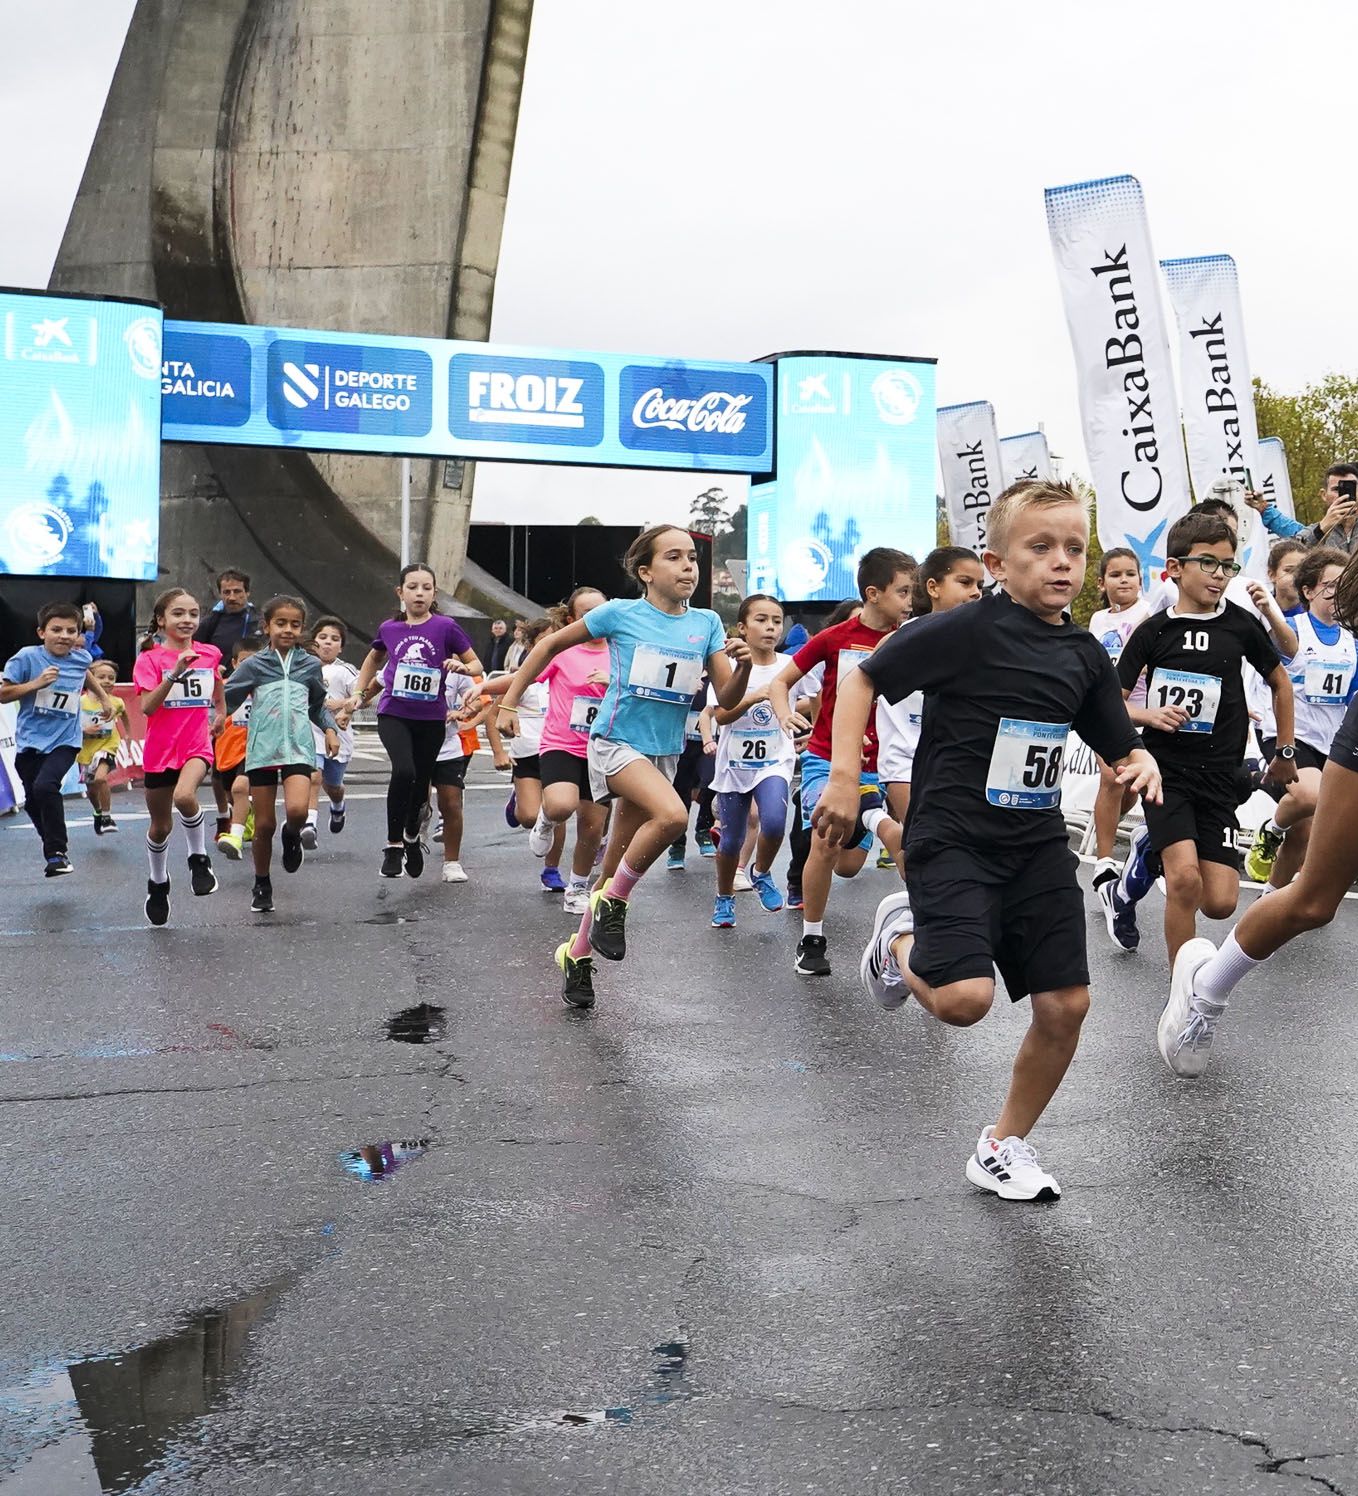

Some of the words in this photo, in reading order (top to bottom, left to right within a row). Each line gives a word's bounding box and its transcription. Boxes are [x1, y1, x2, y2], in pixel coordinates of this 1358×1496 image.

[161, 361, 195, 378] NTA
[1091, 242, 1163, 512] CaixaBank
[161, 378, 235, 398] GALICIA
[334, 370, 418, 391] DEPORTE
[334, 393, 411, 411] GALEGO
[468, 371, 585, 414] FROIZ
[1189, 312, 1246, 490] ixaBank
[631, 387, 754, 434] Coca-Cola
[1182, 630, 1209, 651] 10
[404, 674, 432, 693] 168
[665, 662, 678, 689] 1
[1322, 673, 1343, 695] 41
[182, 678, 202, 697] 15
[52, 692, 69, 709] 77
[1157, 685, 1204, 718] 123
[742, 740, 767, 760] 26
[1023, 745, 1063, 788] 58
